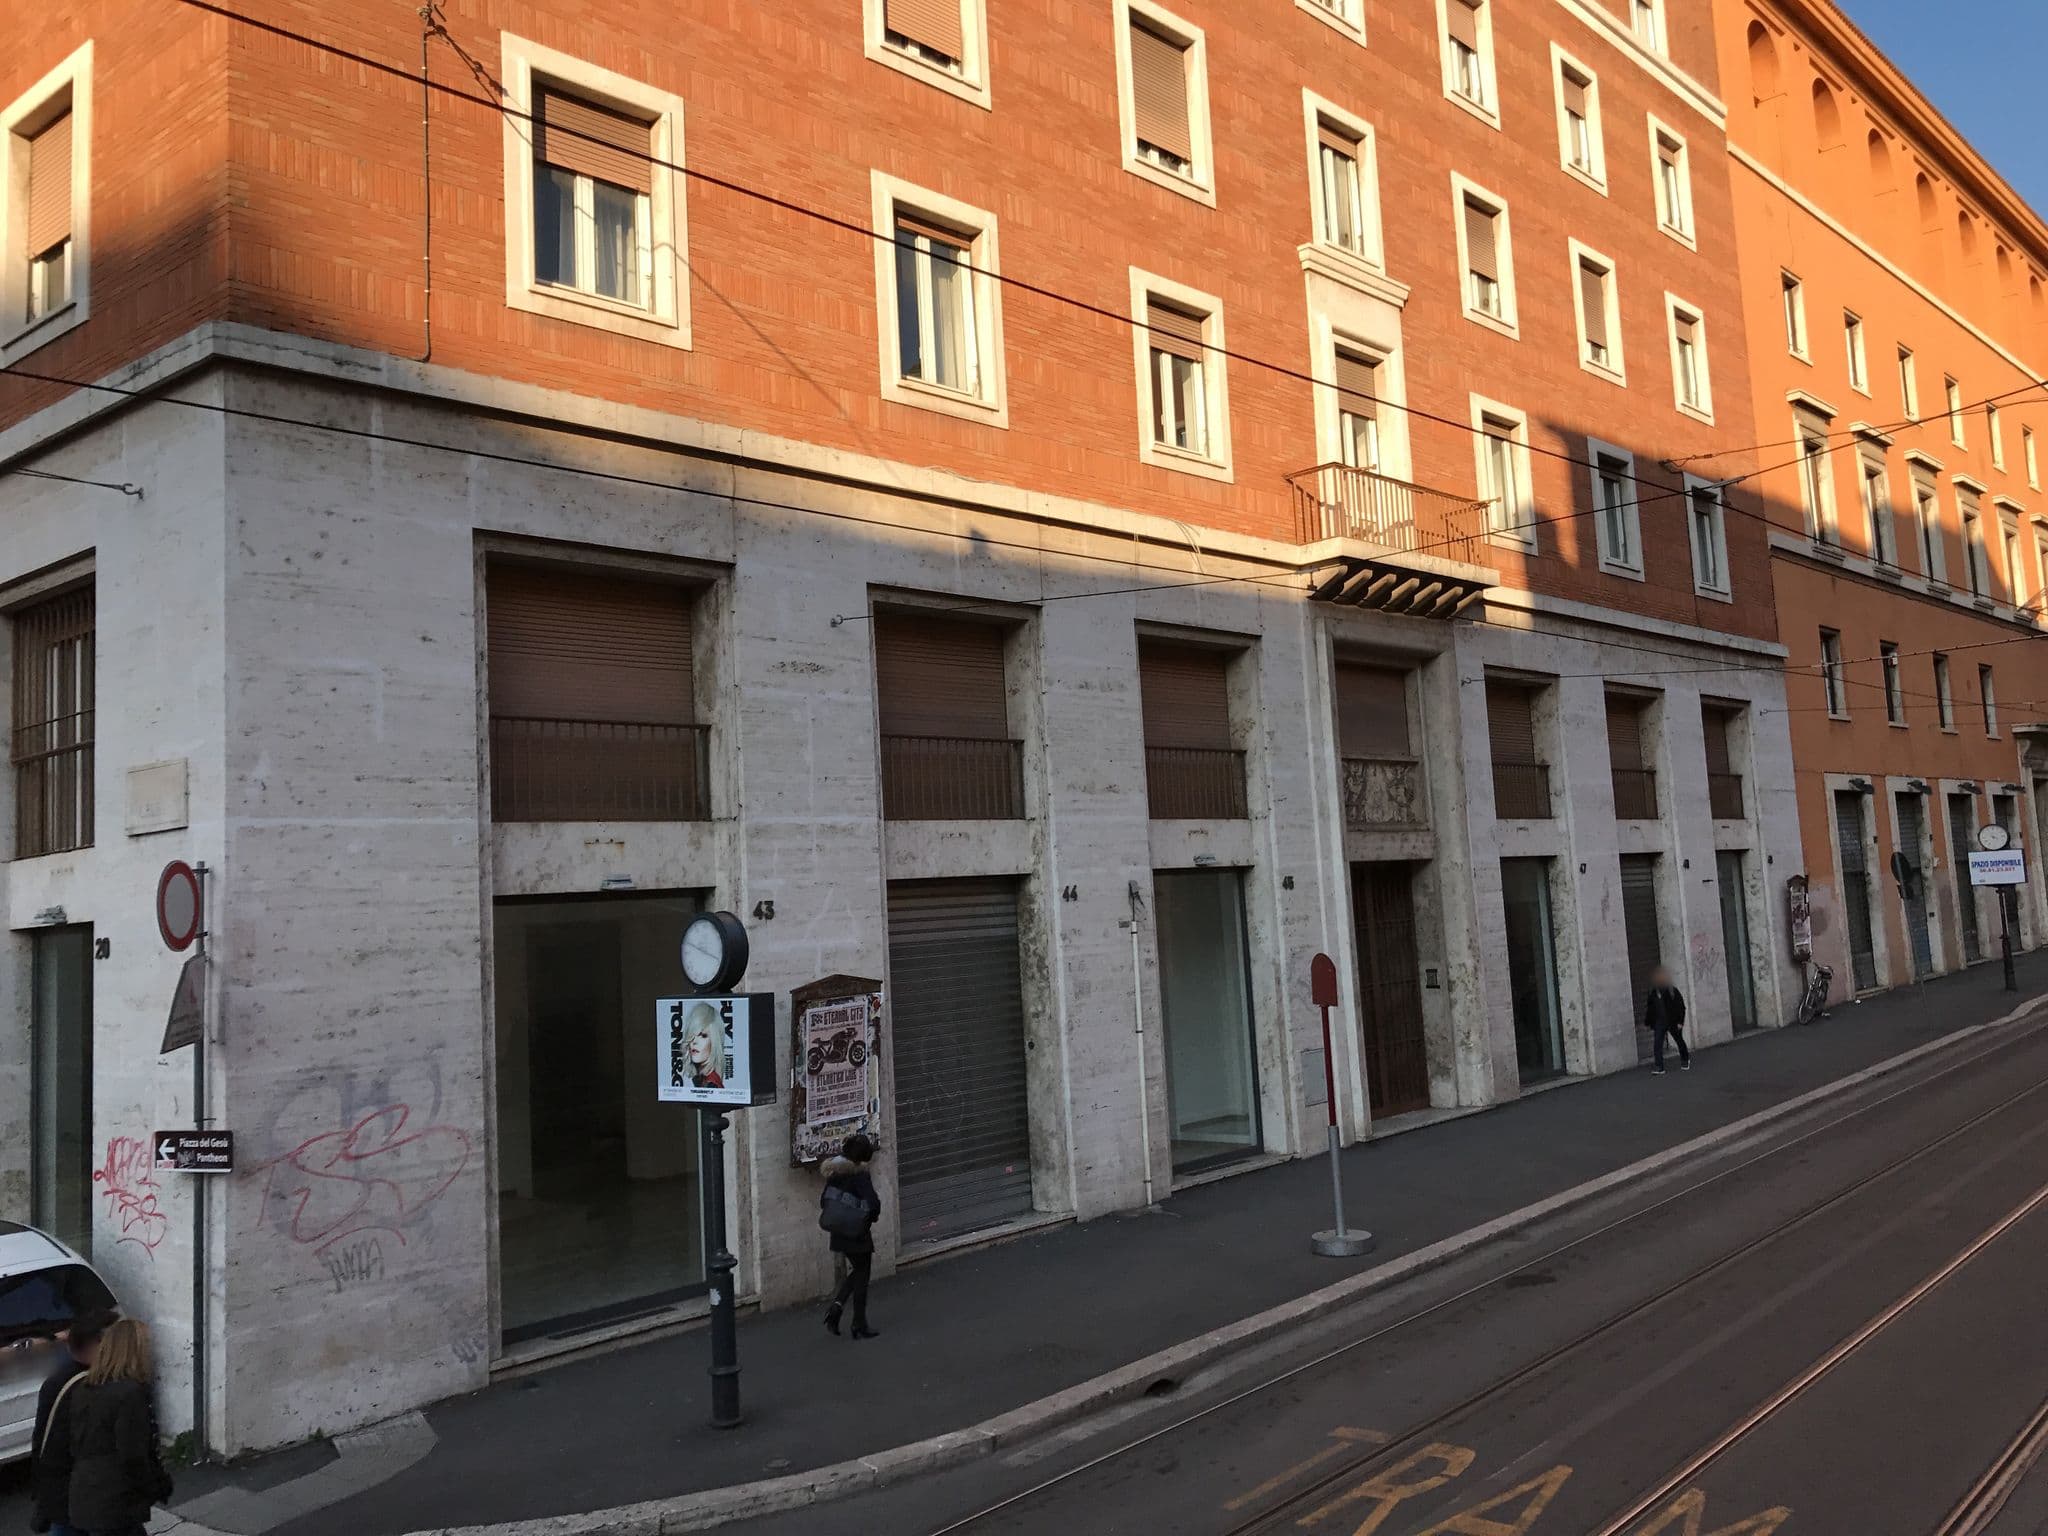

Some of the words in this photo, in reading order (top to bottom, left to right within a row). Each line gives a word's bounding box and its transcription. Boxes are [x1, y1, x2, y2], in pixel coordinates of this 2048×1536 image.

[1971, 860, 1989, 868] SPAZIO
[1990, 859, 2021, 867] DISPONIBILE
[1062, 885, 1078, 902] 44
[752, 900, 775, 920] 43
[95, 937, 110, 960] 20
[179, 1138, 199, 1148] Piazza
[200, 1138, 210, 1148] del
[197, 1152, 228, 1162] Pantheon
